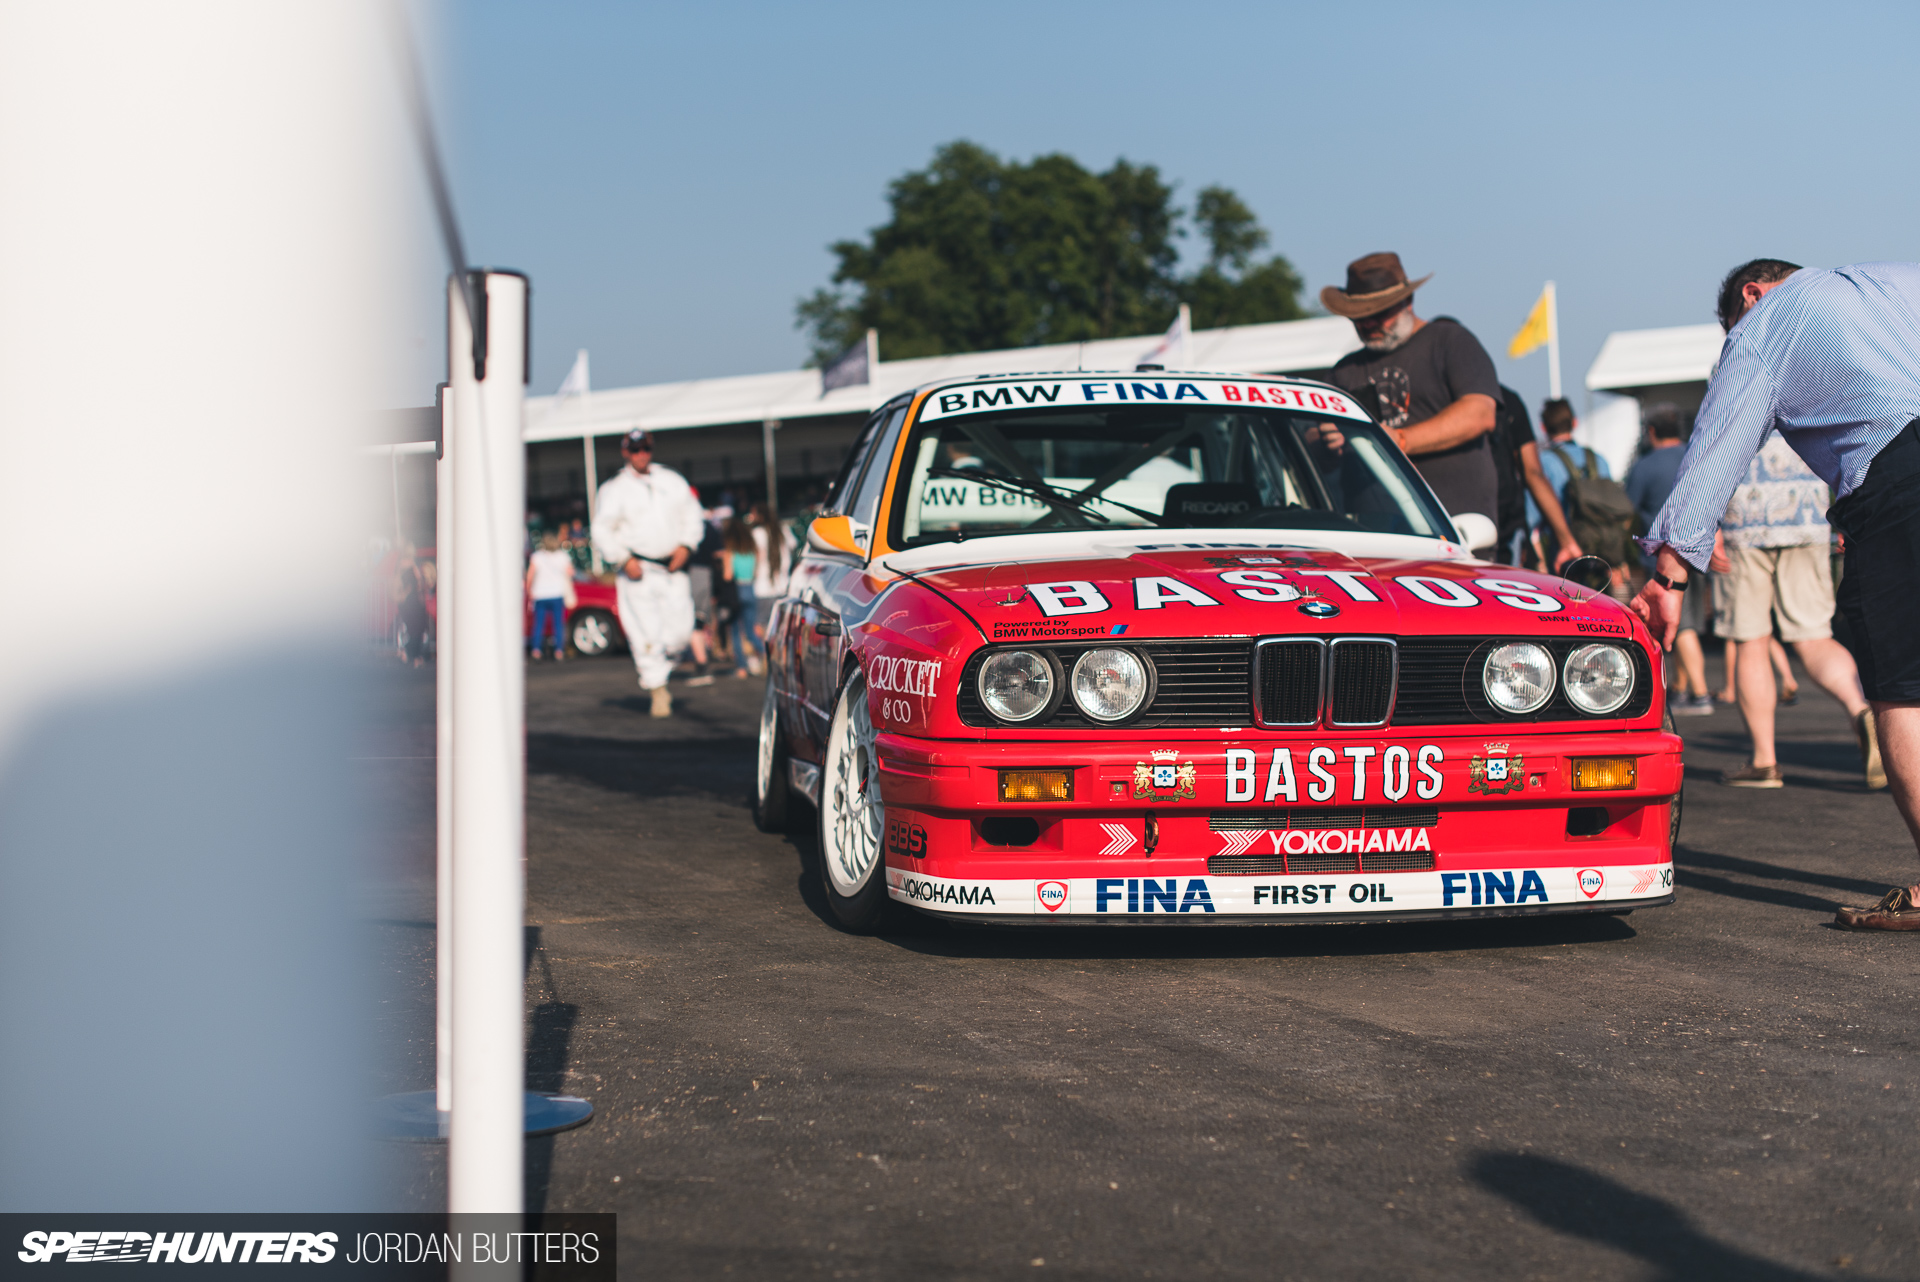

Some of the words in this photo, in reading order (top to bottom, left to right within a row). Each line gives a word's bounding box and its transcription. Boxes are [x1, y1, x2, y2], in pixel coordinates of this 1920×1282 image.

[939, 384, 1061, 413] BMW
[1081, 382, 1208, 401] FINA
[1222, 385, 1347, 414] BASTOS
[923, 486, 967, 506] MW
[1021, 570, 1566, 618] BASTOS
[994, 620, 1050, 629] Powered
[1053, 619, 1070, 627] by
[994, 628, 1029, 638] BMW
[1032, 625, 1106, 637] Motorsport
[1577, 623, 1626, 634] BIGAZZI
[869, 654, 941, 697] CRICKET
[882, 697, 891, 719] &
[893, 699, 911, 723] CO
[1225, 744, 1445, 802] BASTOS
[889, 818, 928, 859] BBS
[1269, 828, 1431, 854] YOKOHAMA
[903, 877, 996, 905] YOKOHAMA
[1041, 890, 1064, 899] FINA
[1253, 884, 1336, 905] FIRST
[1349, 883, 1393, 903] OIL
[1440, 870, 1549, 906] FINA
[1582, 877, 1601, 886] FINA
[1096, 879, 1216, 912] FINA
